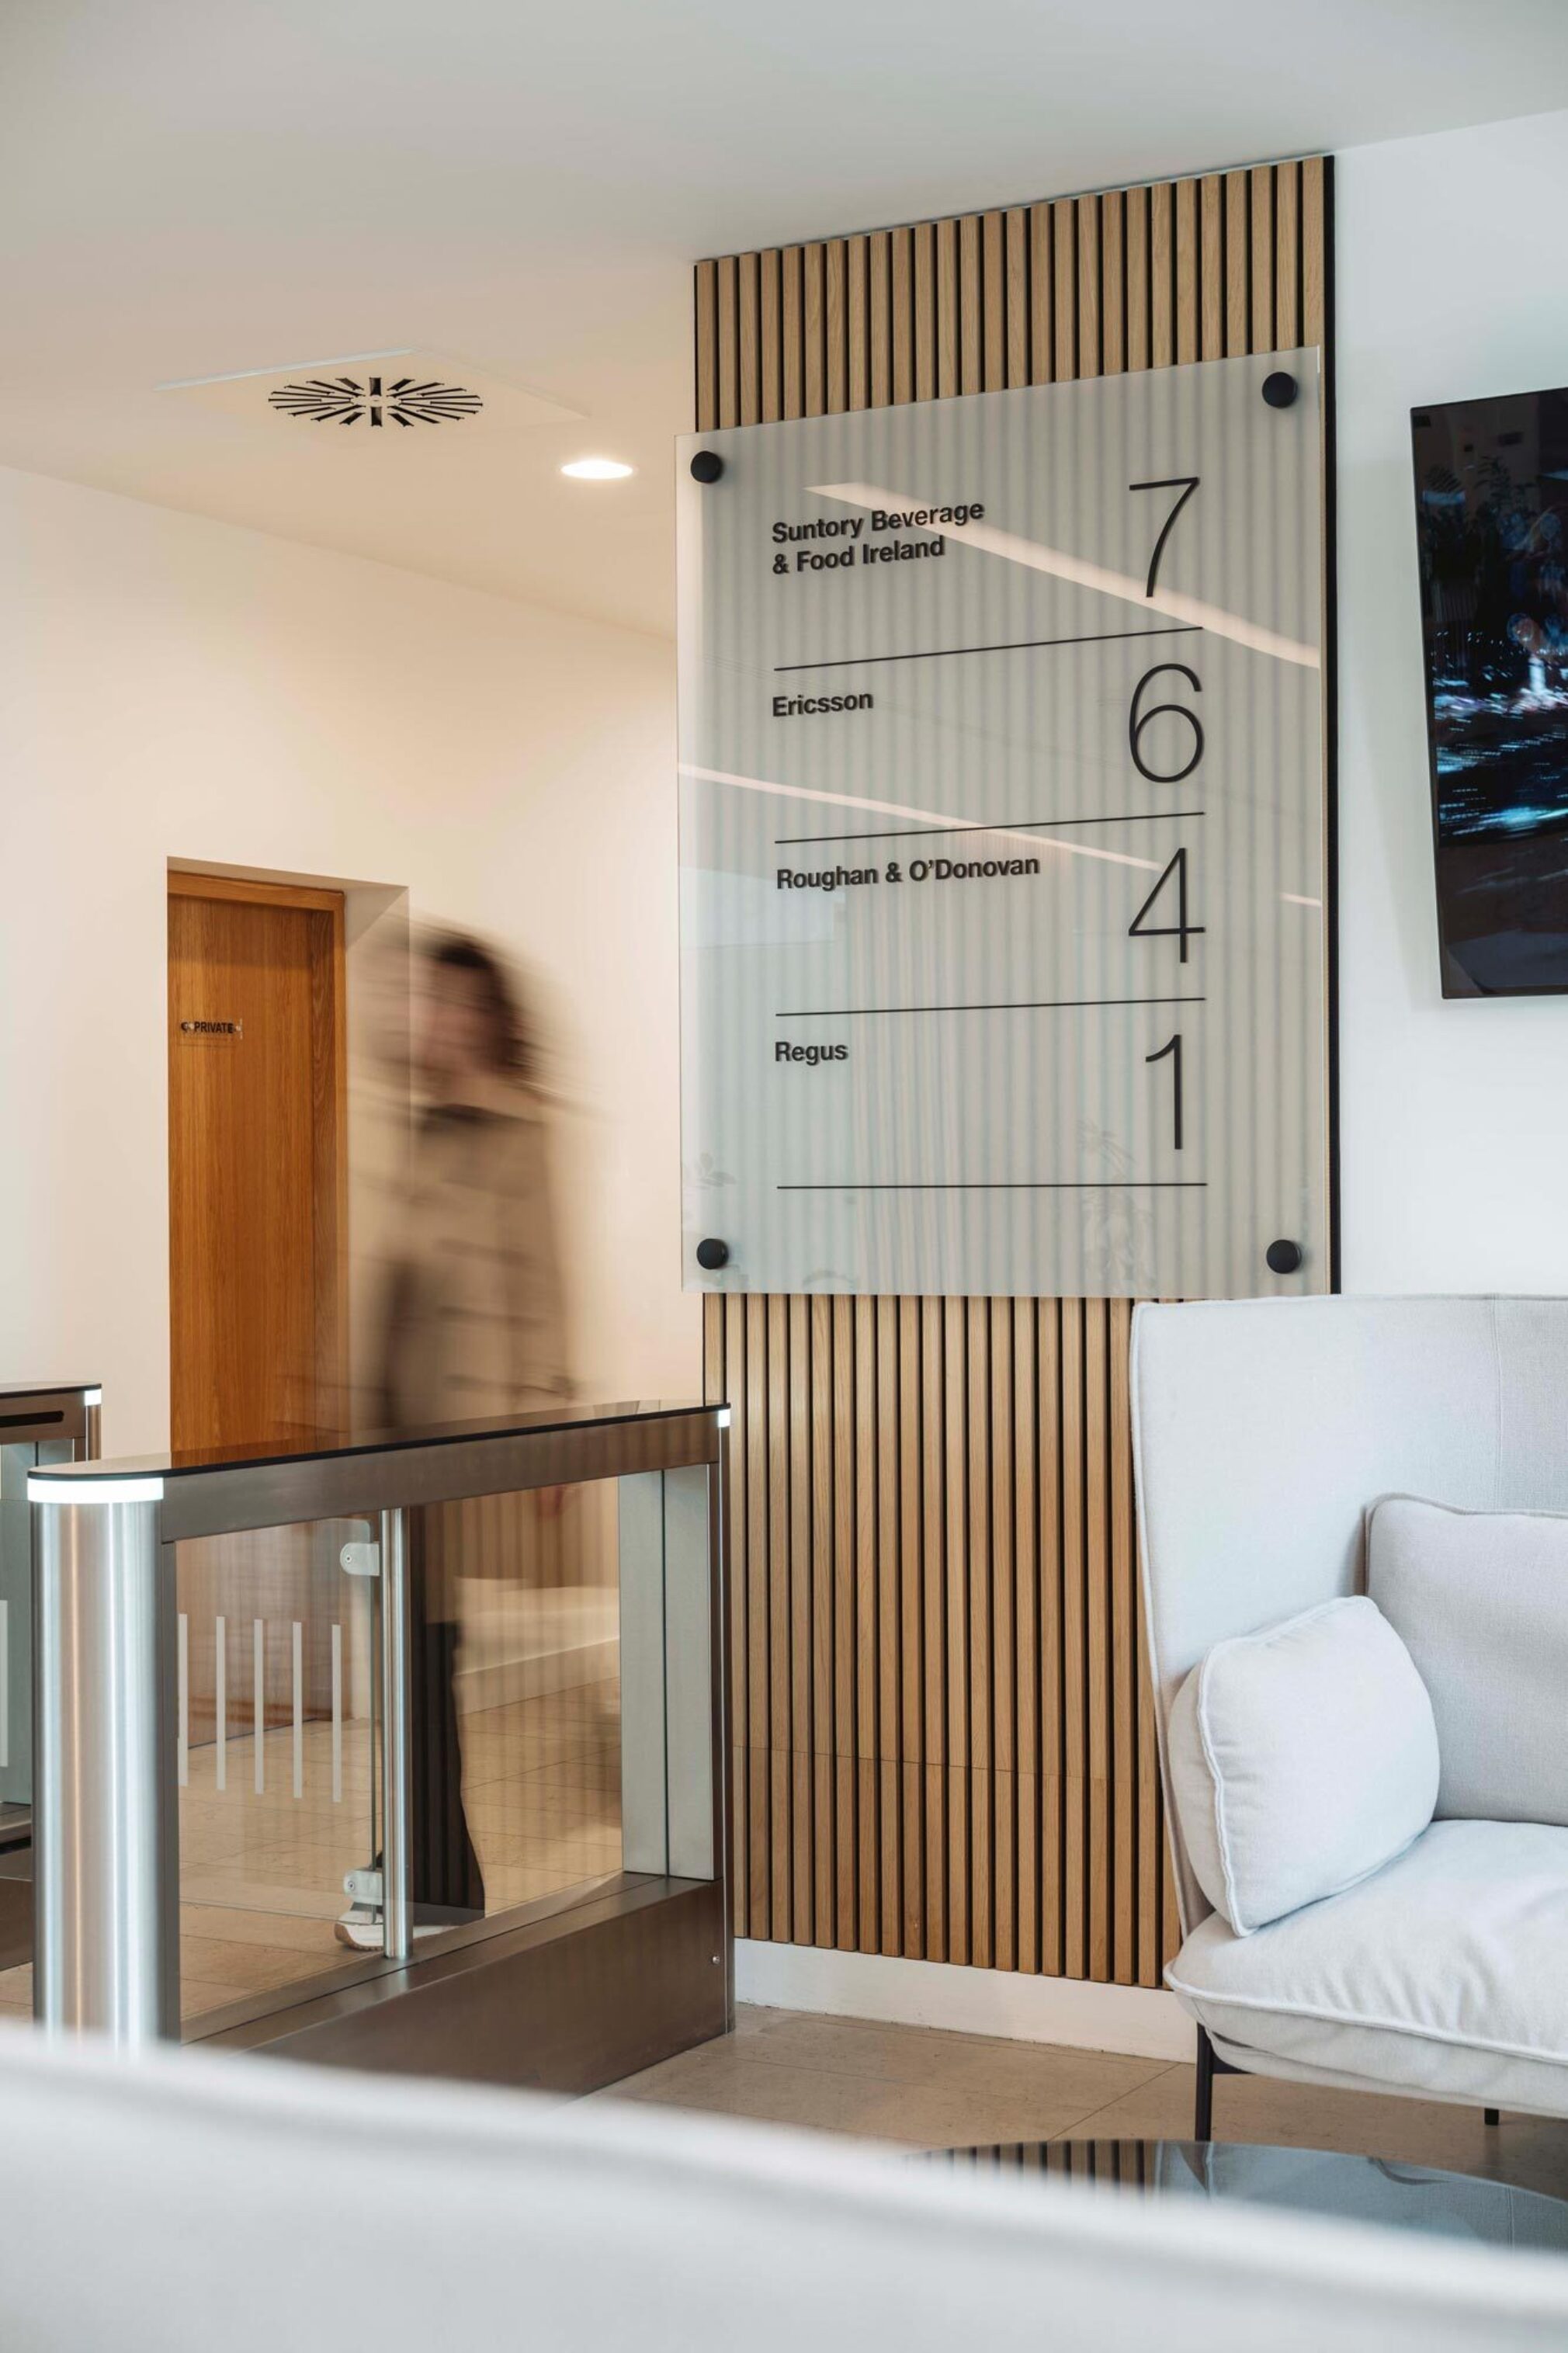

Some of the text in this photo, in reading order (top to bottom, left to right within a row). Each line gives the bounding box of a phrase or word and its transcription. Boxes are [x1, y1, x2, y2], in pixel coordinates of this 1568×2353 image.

[772, 502, 985, 543] Suntory Beverage
[1129, 477, 1200, 598] 7
[772, 536, 946, 574] & Food Ireland
[772, 691, 874, 717] Ericsson
[1129, 663, 1204, 784] 6
[776, 865, 879, 891] Roughan
[885, 862, 902, 883] &
[1128, 847, 1206, 963] 4
[194, 1021, 235, 1033] PRIVATE
[775, 1040, 848, 1066] Regus
[1145, 1033, 1183, 1150] 1
